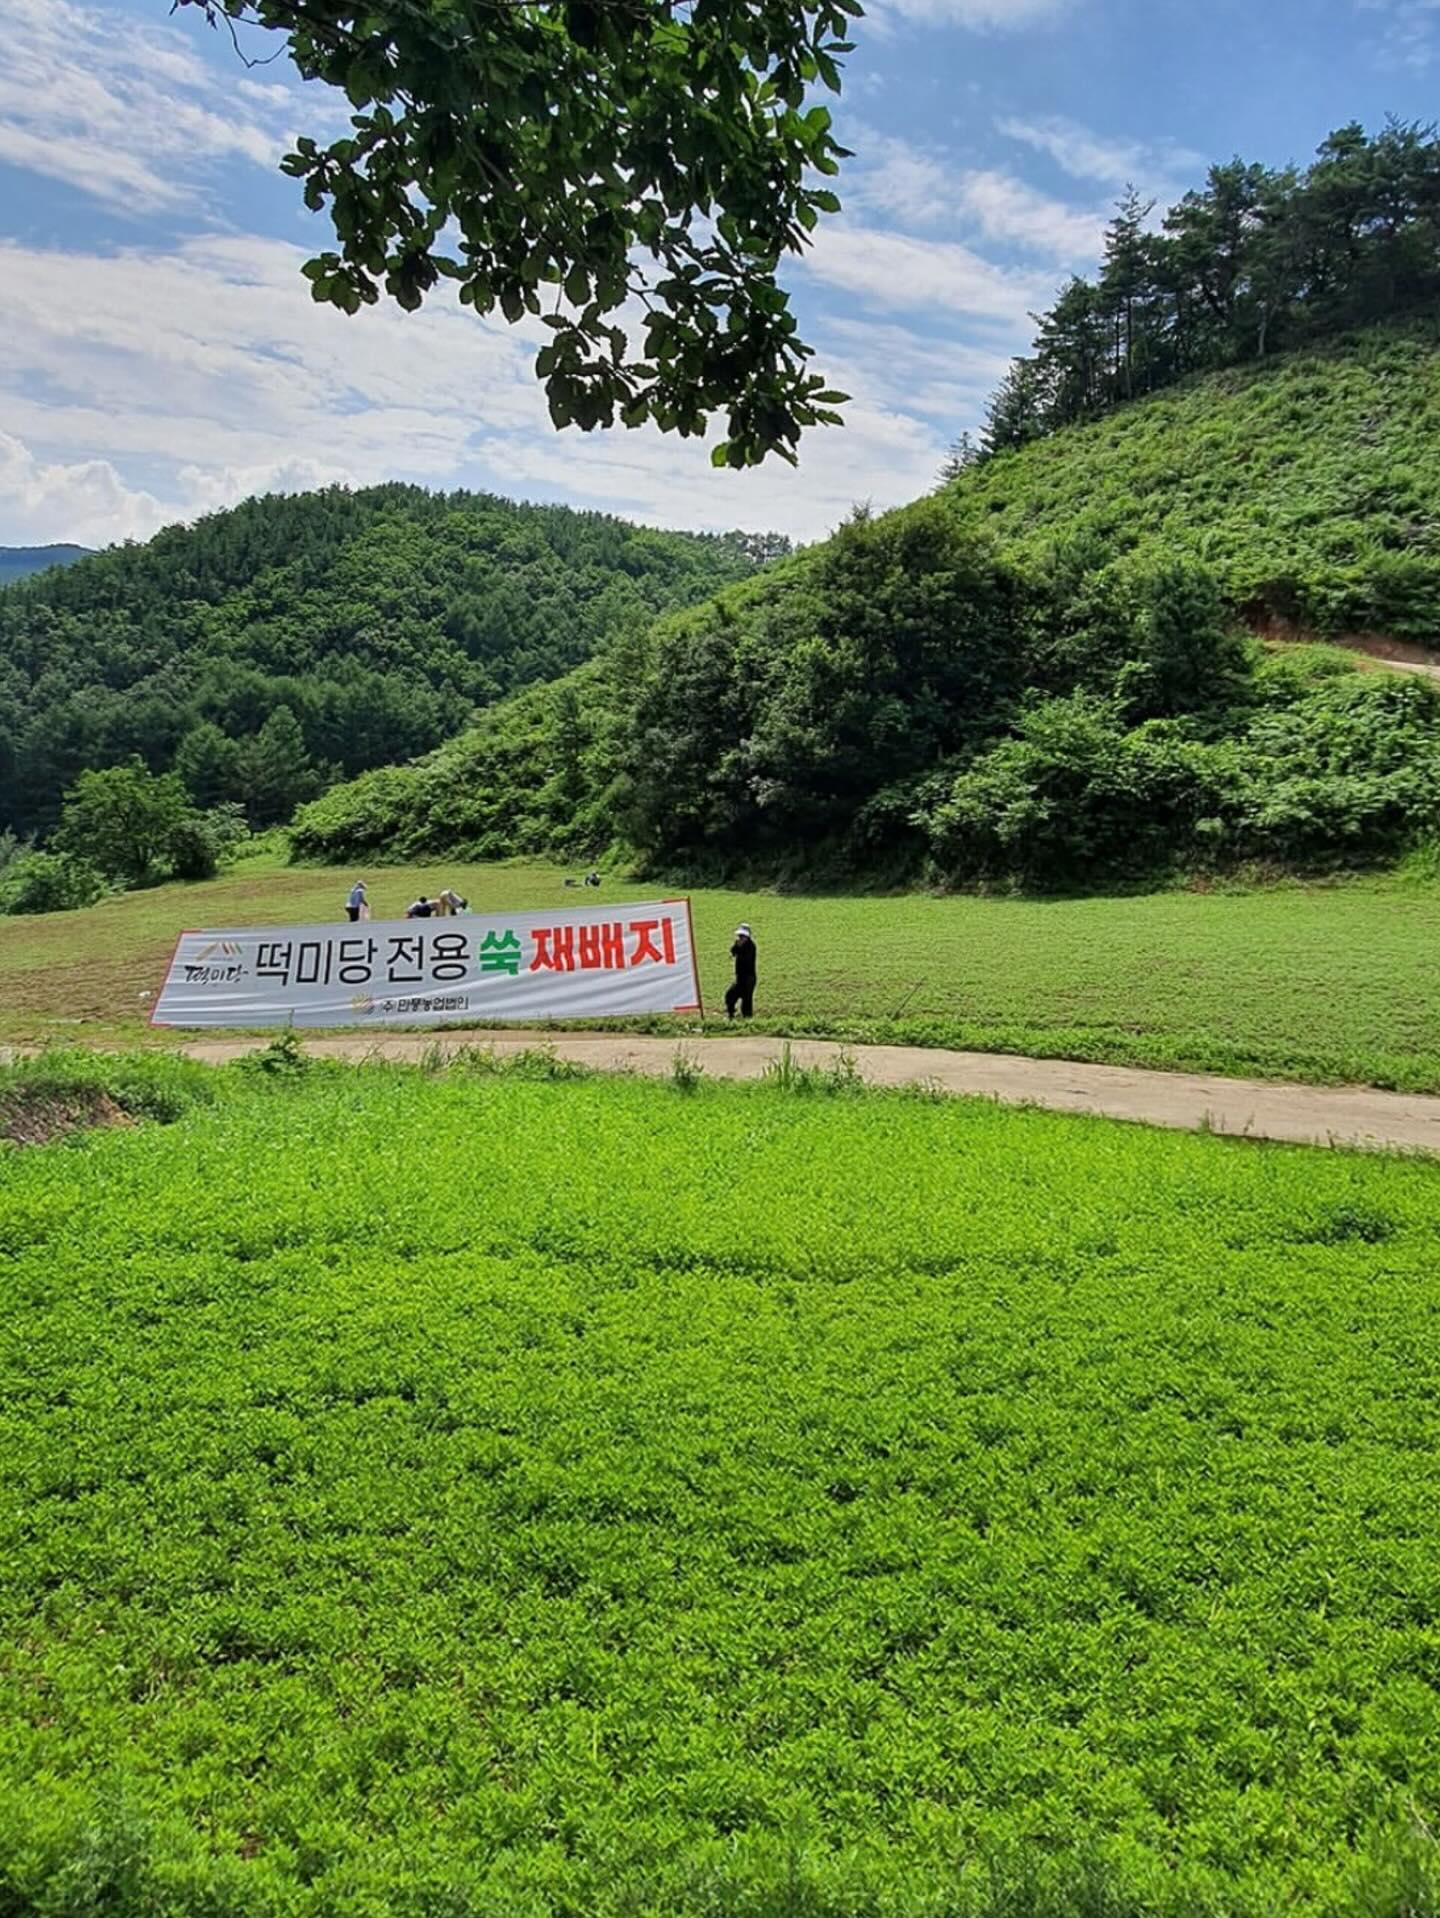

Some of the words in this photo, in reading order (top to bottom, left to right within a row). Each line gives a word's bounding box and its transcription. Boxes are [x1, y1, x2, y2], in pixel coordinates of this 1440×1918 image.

[256, 940, 378, 986] 떡미당
[386, 933, 470, 983] 전용
[479, 929, 521, 975] 쑥
[529, 917, 676, 972] 재배지
